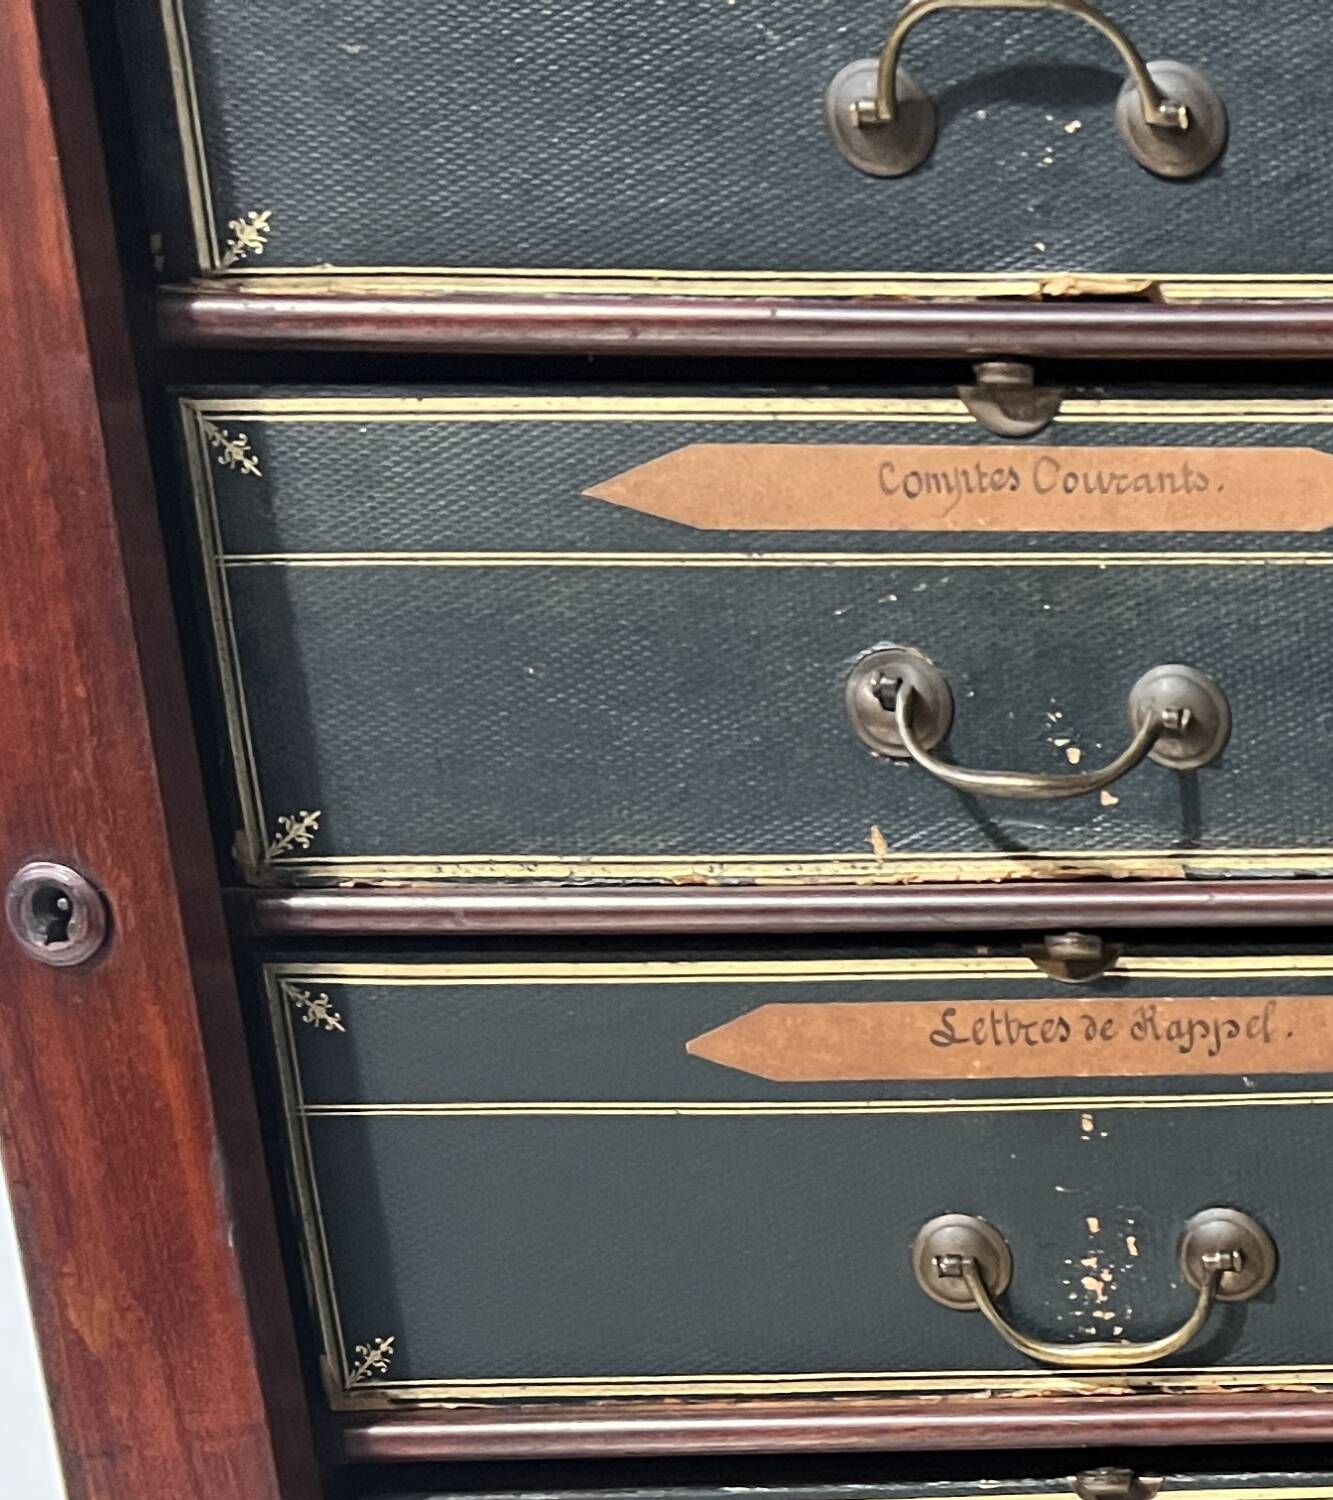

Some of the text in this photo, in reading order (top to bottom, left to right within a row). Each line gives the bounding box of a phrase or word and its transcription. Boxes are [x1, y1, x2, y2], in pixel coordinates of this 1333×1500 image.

[879, 461, 1021, 518] Comptes
[929, 1007, 1071, 1048] Lettres
[1081, 1014, 1118, 1042] de
